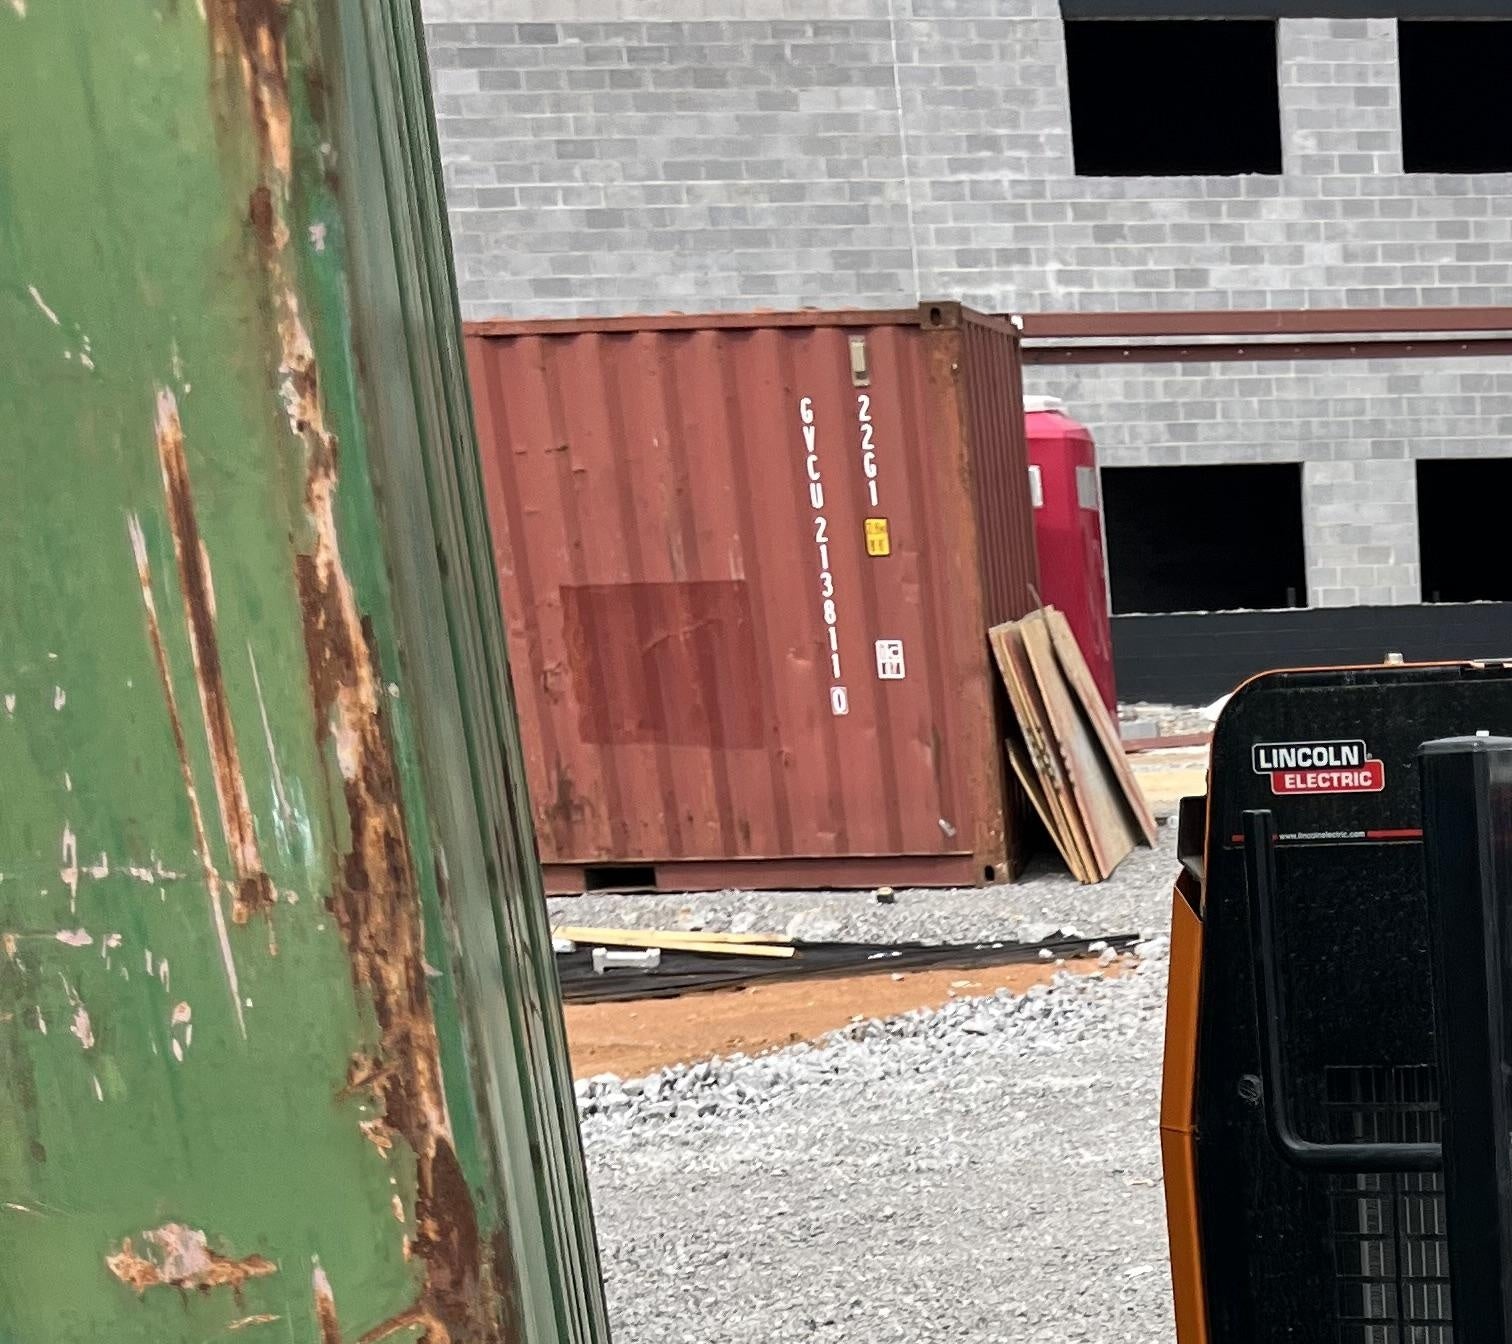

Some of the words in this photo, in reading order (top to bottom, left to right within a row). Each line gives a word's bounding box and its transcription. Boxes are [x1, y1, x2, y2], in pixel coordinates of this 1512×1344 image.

[857, 394, 879, 507] 22G1
[800, 397, 824, 509] GVCU
[814, 516, 841, 679] 213811
[1259, 745, 1360, 769] LINCOLN
[1284, 771, 1373, 790] ELECTRIC
[1279, 831, 1366, 840] www.lincolnelectric.com
